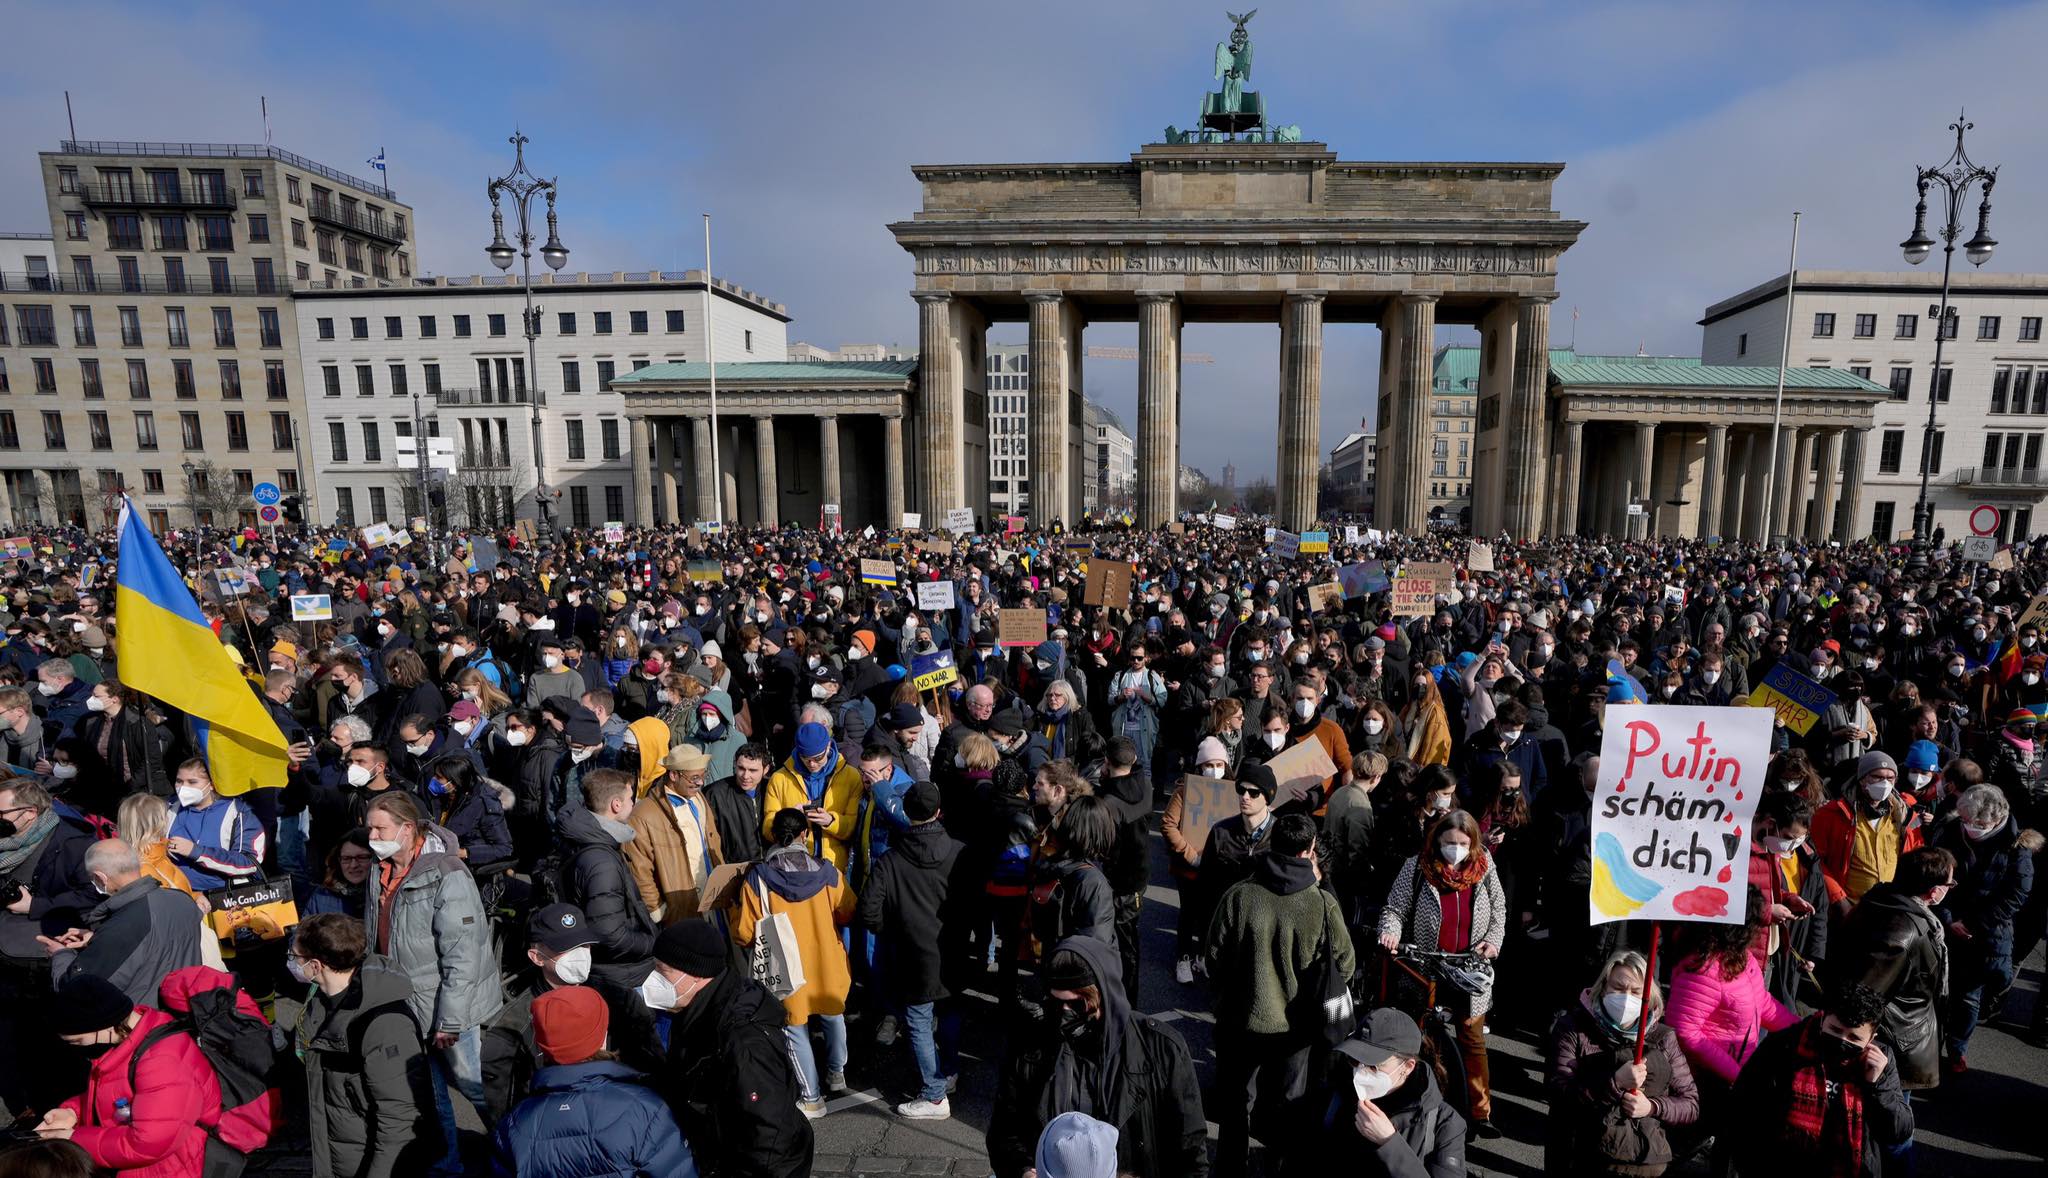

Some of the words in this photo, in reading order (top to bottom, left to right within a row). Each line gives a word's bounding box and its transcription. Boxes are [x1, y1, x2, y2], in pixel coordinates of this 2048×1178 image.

[1396, 594, 1412, 604] THE
[1414, 594, 1434, 604] SKY
[1397, 580, 1432, 593] CLOSE
[917, 678, 930, 689] NO
[931, 670, 949, 684] WAR
[1775, 671, 1828, 704] STOP
[1764, 690, 1809, 729] WAR
[1624, 720, 1741, 788] Putin
[1601, 781, 1726, 822] schäm
[223, 898, 238, 908] We
[237, 895, 255, 905] Can
[255, 891, 269, 901] Do
